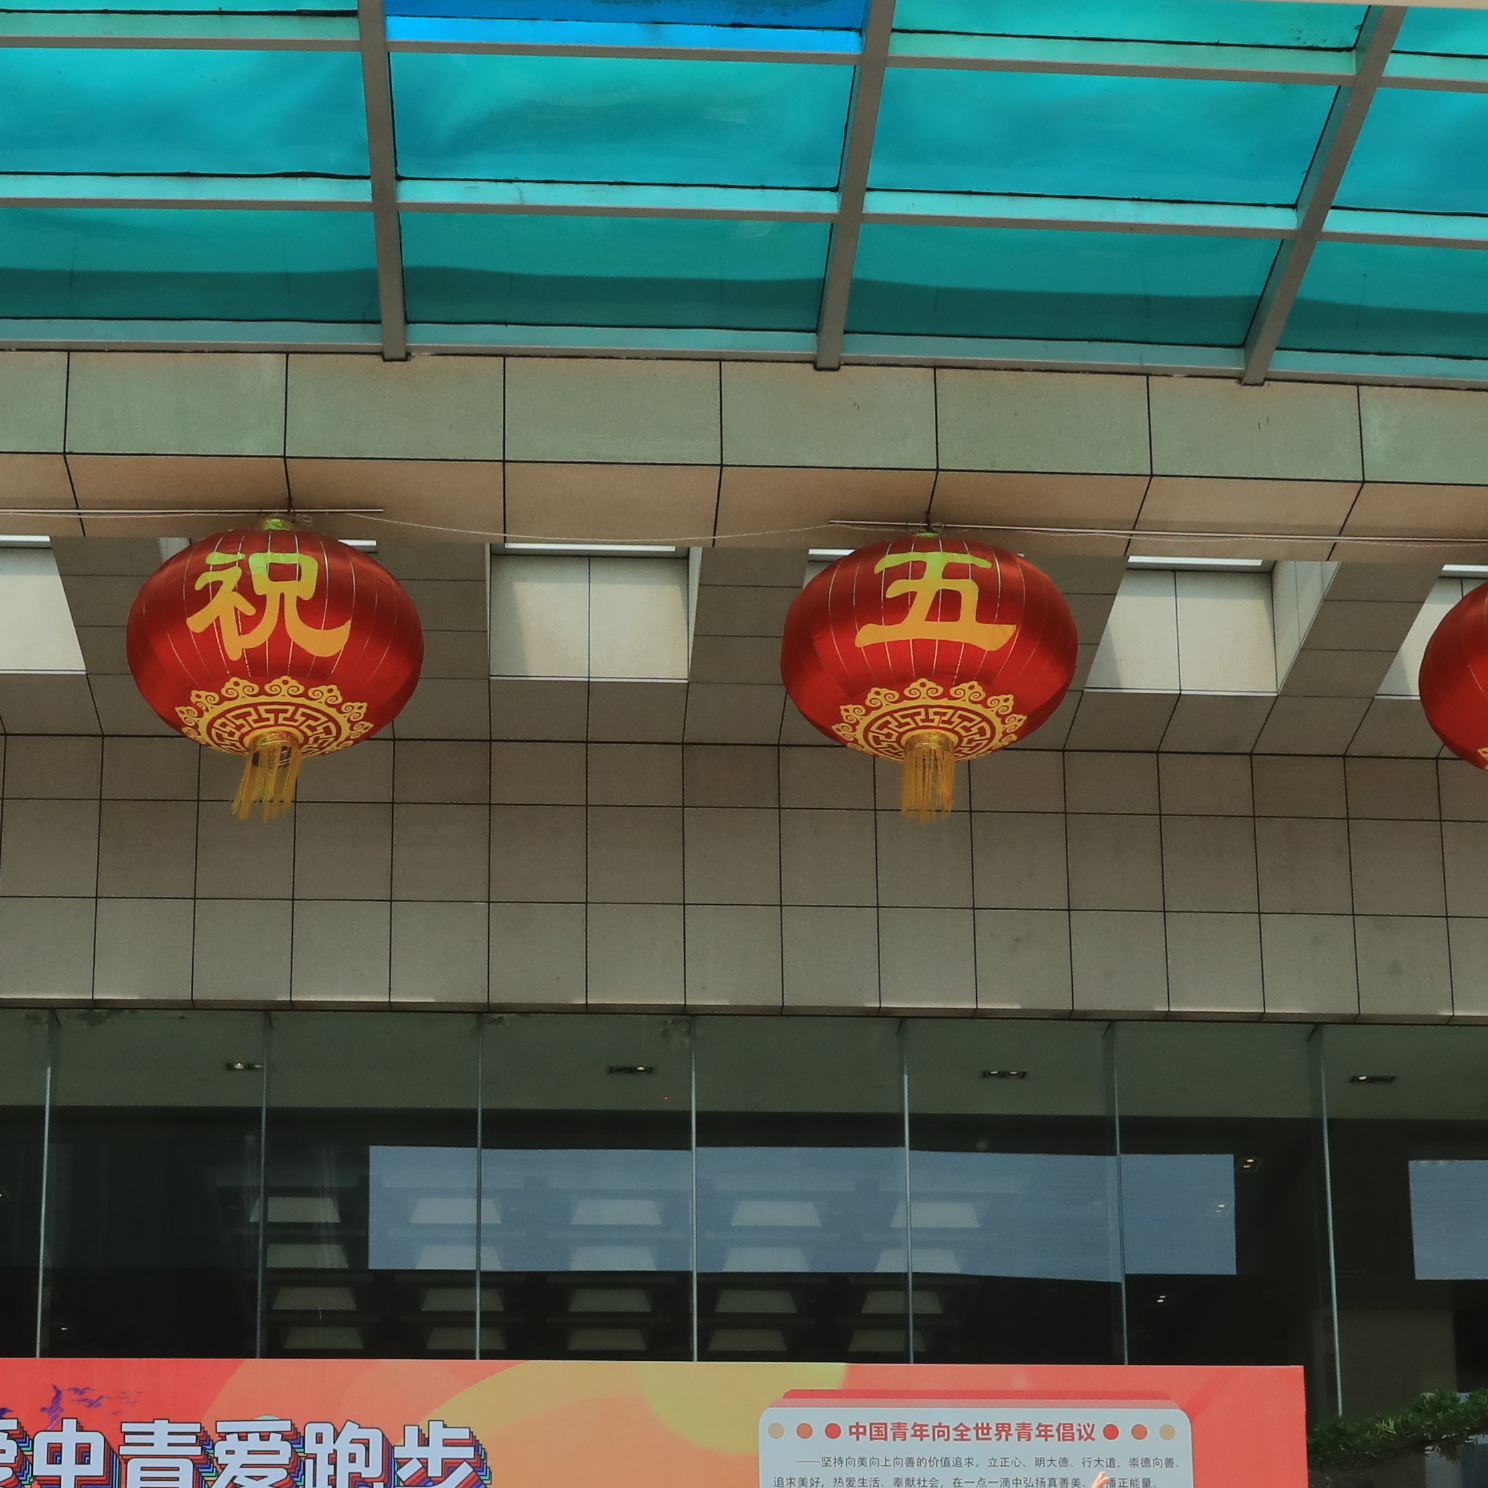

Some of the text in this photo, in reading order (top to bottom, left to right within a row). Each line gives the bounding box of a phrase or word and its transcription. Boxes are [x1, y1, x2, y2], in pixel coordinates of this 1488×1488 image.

[186, 550, 352, 661] 祝
[855, 547, 1017, 652] 五
[848, 1421, 1096, 1442] 中国青年向全世界青年倡议
[773, 1476, 1158, 1488] 追求美好，热爱生活、奉献社会，在一点一滴中弘扬真善美、播正能量。
